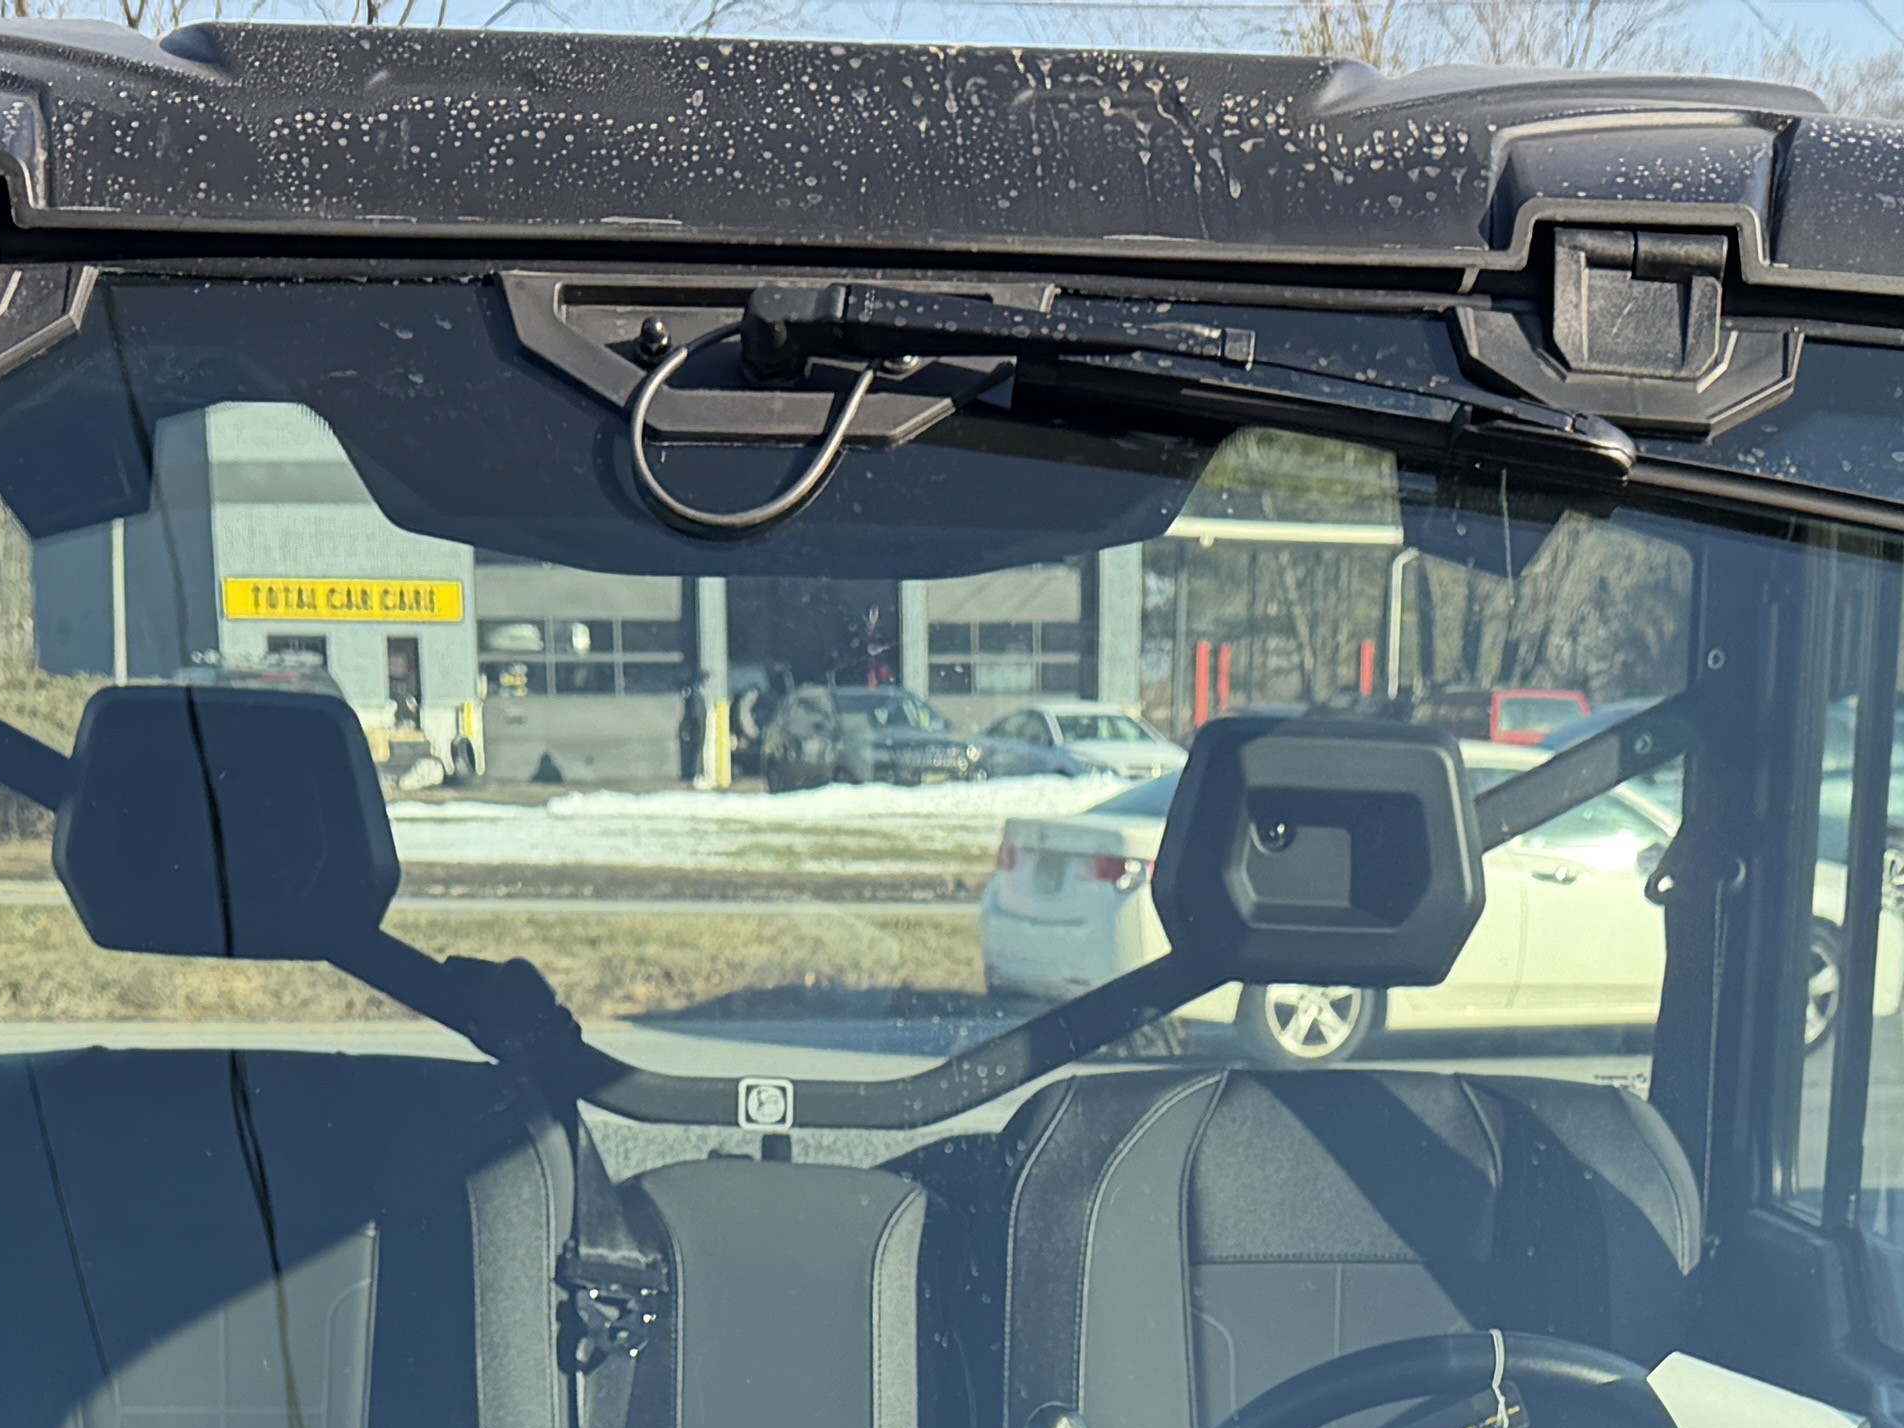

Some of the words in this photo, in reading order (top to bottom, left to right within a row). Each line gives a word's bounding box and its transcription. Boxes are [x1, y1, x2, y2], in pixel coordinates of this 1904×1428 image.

[251, 585, 318, 612] TOTAL
[326, 586, 374, 612] CAR
[380, 587, 438, 614] CARE
